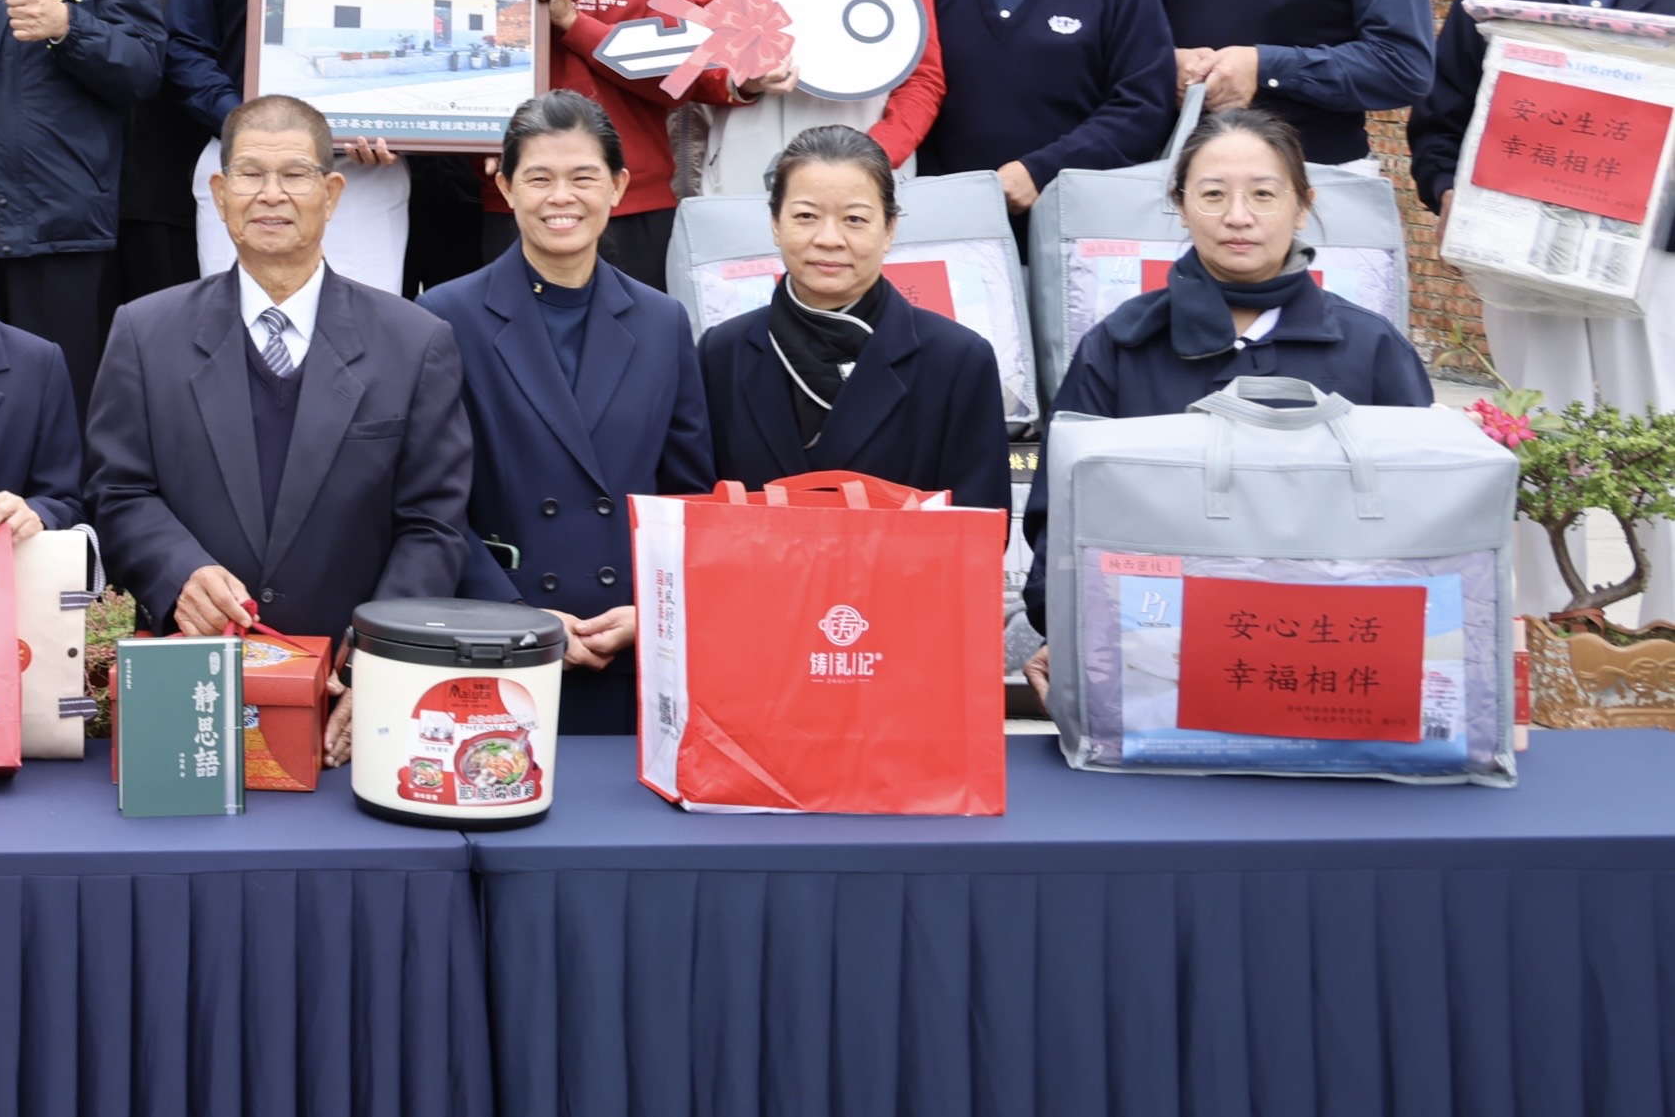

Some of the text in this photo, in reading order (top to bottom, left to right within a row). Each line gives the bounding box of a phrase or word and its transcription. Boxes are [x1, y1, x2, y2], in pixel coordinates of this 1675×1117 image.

[1509, 98, 1632, 142] 安心生活
[1500, 134, 1622, 182] 幸福相伴
[1225, 611, 1383, 645] 安心生活
[1224, 658, 1381, 697] 幸福相伴
[192, 681, 220, 777] 靜思語
